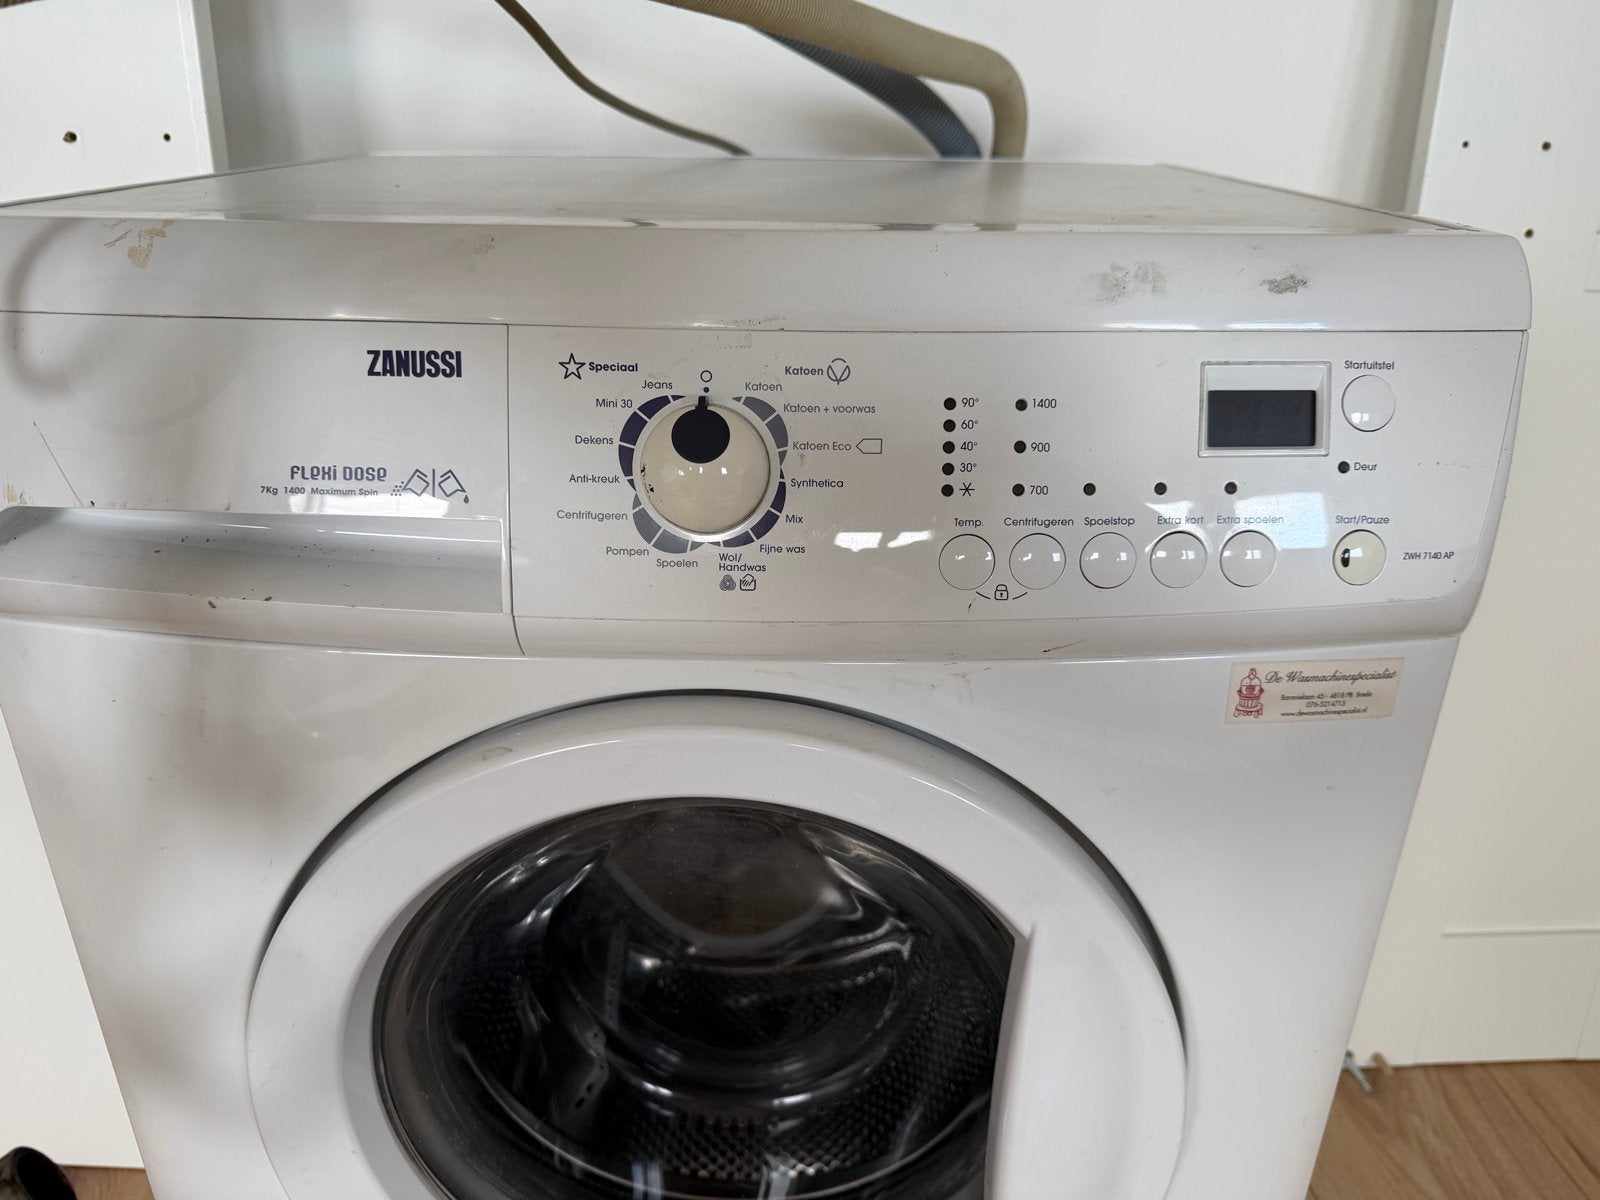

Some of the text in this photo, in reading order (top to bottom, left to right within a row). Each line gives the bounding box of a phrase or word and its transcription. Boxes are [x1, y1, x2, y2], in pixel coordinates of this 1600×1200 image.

[366, 350, 463, 378] ZANUSSI
[588, 361, 639, 373] Speciaal
[1344, 360, 1395, 371] Startuitstel
[784, 365, 824, 377] Katoen
[641, 379, 673, 390] Jeans
[744, 381, 783, 392] Katoen
[595, 398, 633, 409] Mini 30
[783, 403, 821, 414] Katoen
[832, 404, 876, 414] voorwas
[1032, 398, 1057, 409] 1400
[574, 434, 614, 446] Dekens
[792, 441, 852, 452] Katoen Eco
[1030, 442, 1051, 453] 900
[1353, 461, 1378, 472] Deur
[569, 473, 621, 484] Anti-kreuk
[790, 478, 844, 490] Synthetica
[260, 485, 379, 498] 7Kg 1400 Maximum Spin
[1029, 485, 1049, 496] 700
[556, 509, 628, 522] Centrifugeren
[785, 514, 804, 524] Mix
[1157, 515, 1205, 526] Extra kort
[1216, 515, 1285, 526] Extra spoelen
[1335, 515, 1391, 525] Start/Pauze
[954, 517, 984, 529] Temp.
[1004, 517, 1074, 529] Centrifugeren
[1084, 516, 1136, 527] Spoelstop
[606, 546, 650, 557] Pompen
[759, 544, 806, 556] Fijne was
[718, 553, 742, 563] Wol/
[1402, 551, 1455, 561] ZWH 7140 AP
[656, 558, 699, 569] Spoelen
[718, 562, 767, 573] Handwas
[1264, 670, 1282, 684] De
